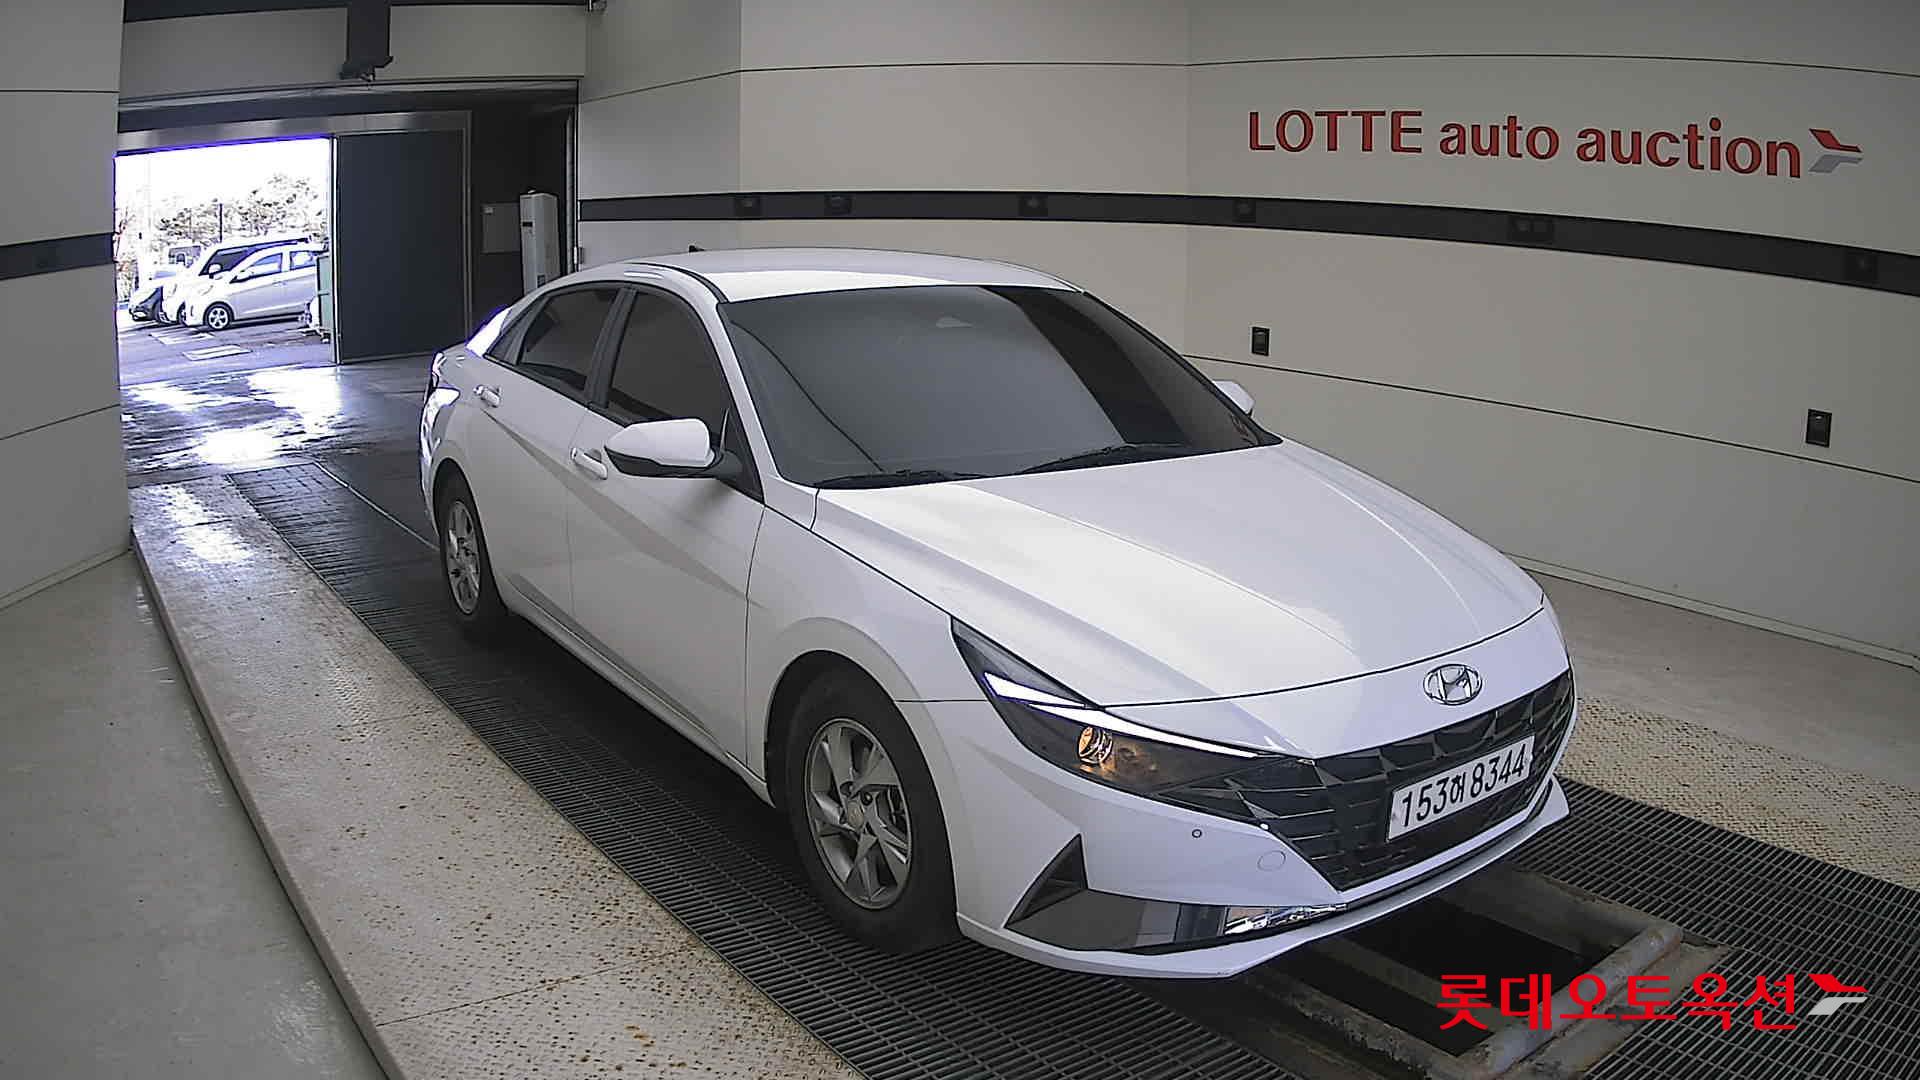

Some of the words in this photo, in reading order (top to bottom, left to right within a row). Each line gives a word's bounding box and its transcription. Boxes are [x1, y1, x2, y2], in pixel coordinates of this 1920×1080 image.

[1248, 110, 1423, 153] LOTTE
[1438, 115, 1560, 160] auto
[1575, 117, 1802, 179] auction
